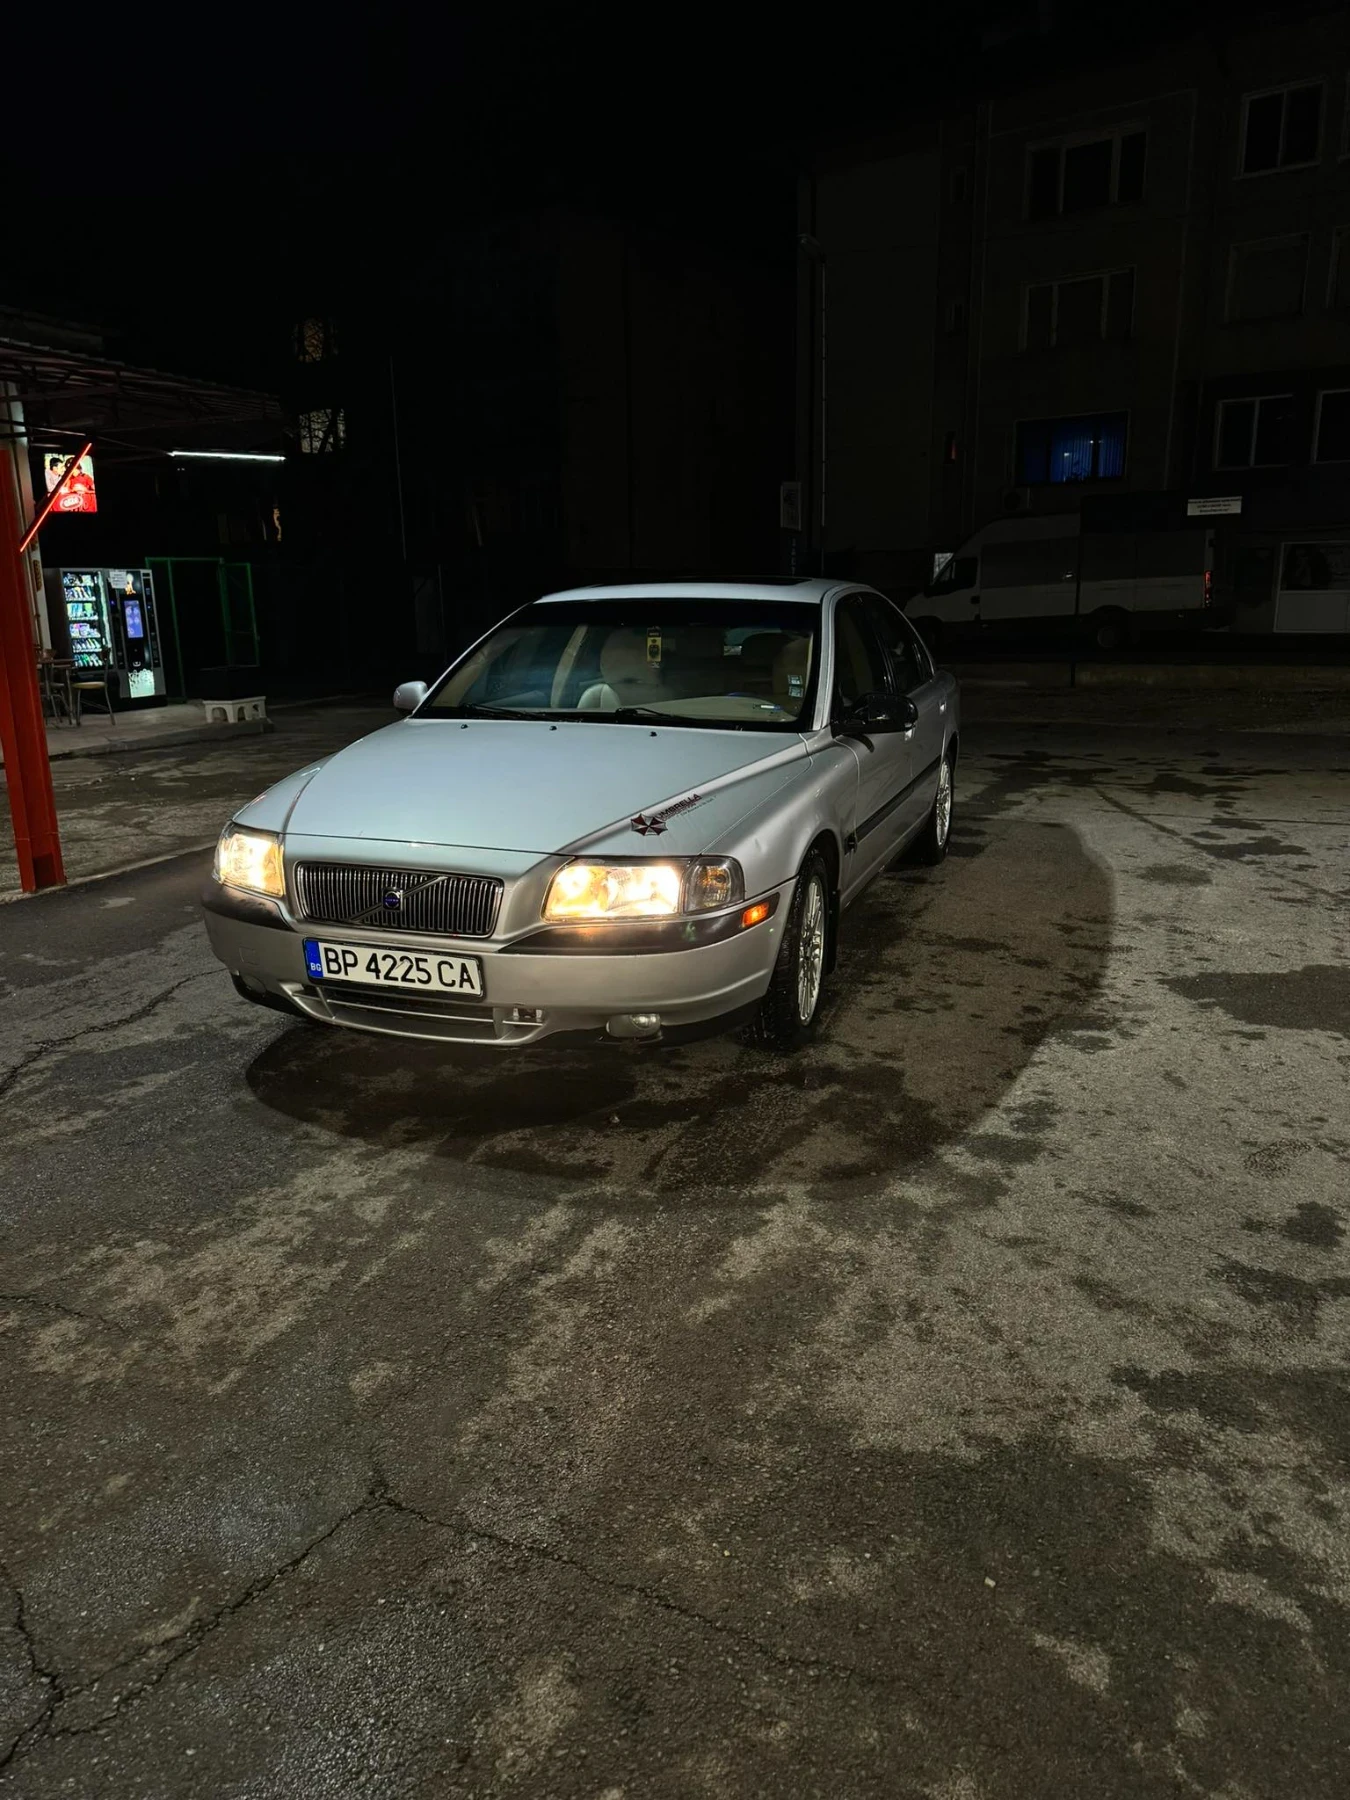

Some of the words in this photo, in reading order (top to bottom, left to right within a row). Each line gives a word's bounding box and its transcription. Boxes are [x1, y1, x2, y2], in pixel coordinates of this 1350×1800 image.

[656, 793, 703, 819] UMBRELLA
[310, 962, 322, 972] BG
[323, 947, 358, 976] BP
[365, 952, 432, 985] 4225
[436, 960, 475, 990] CA
